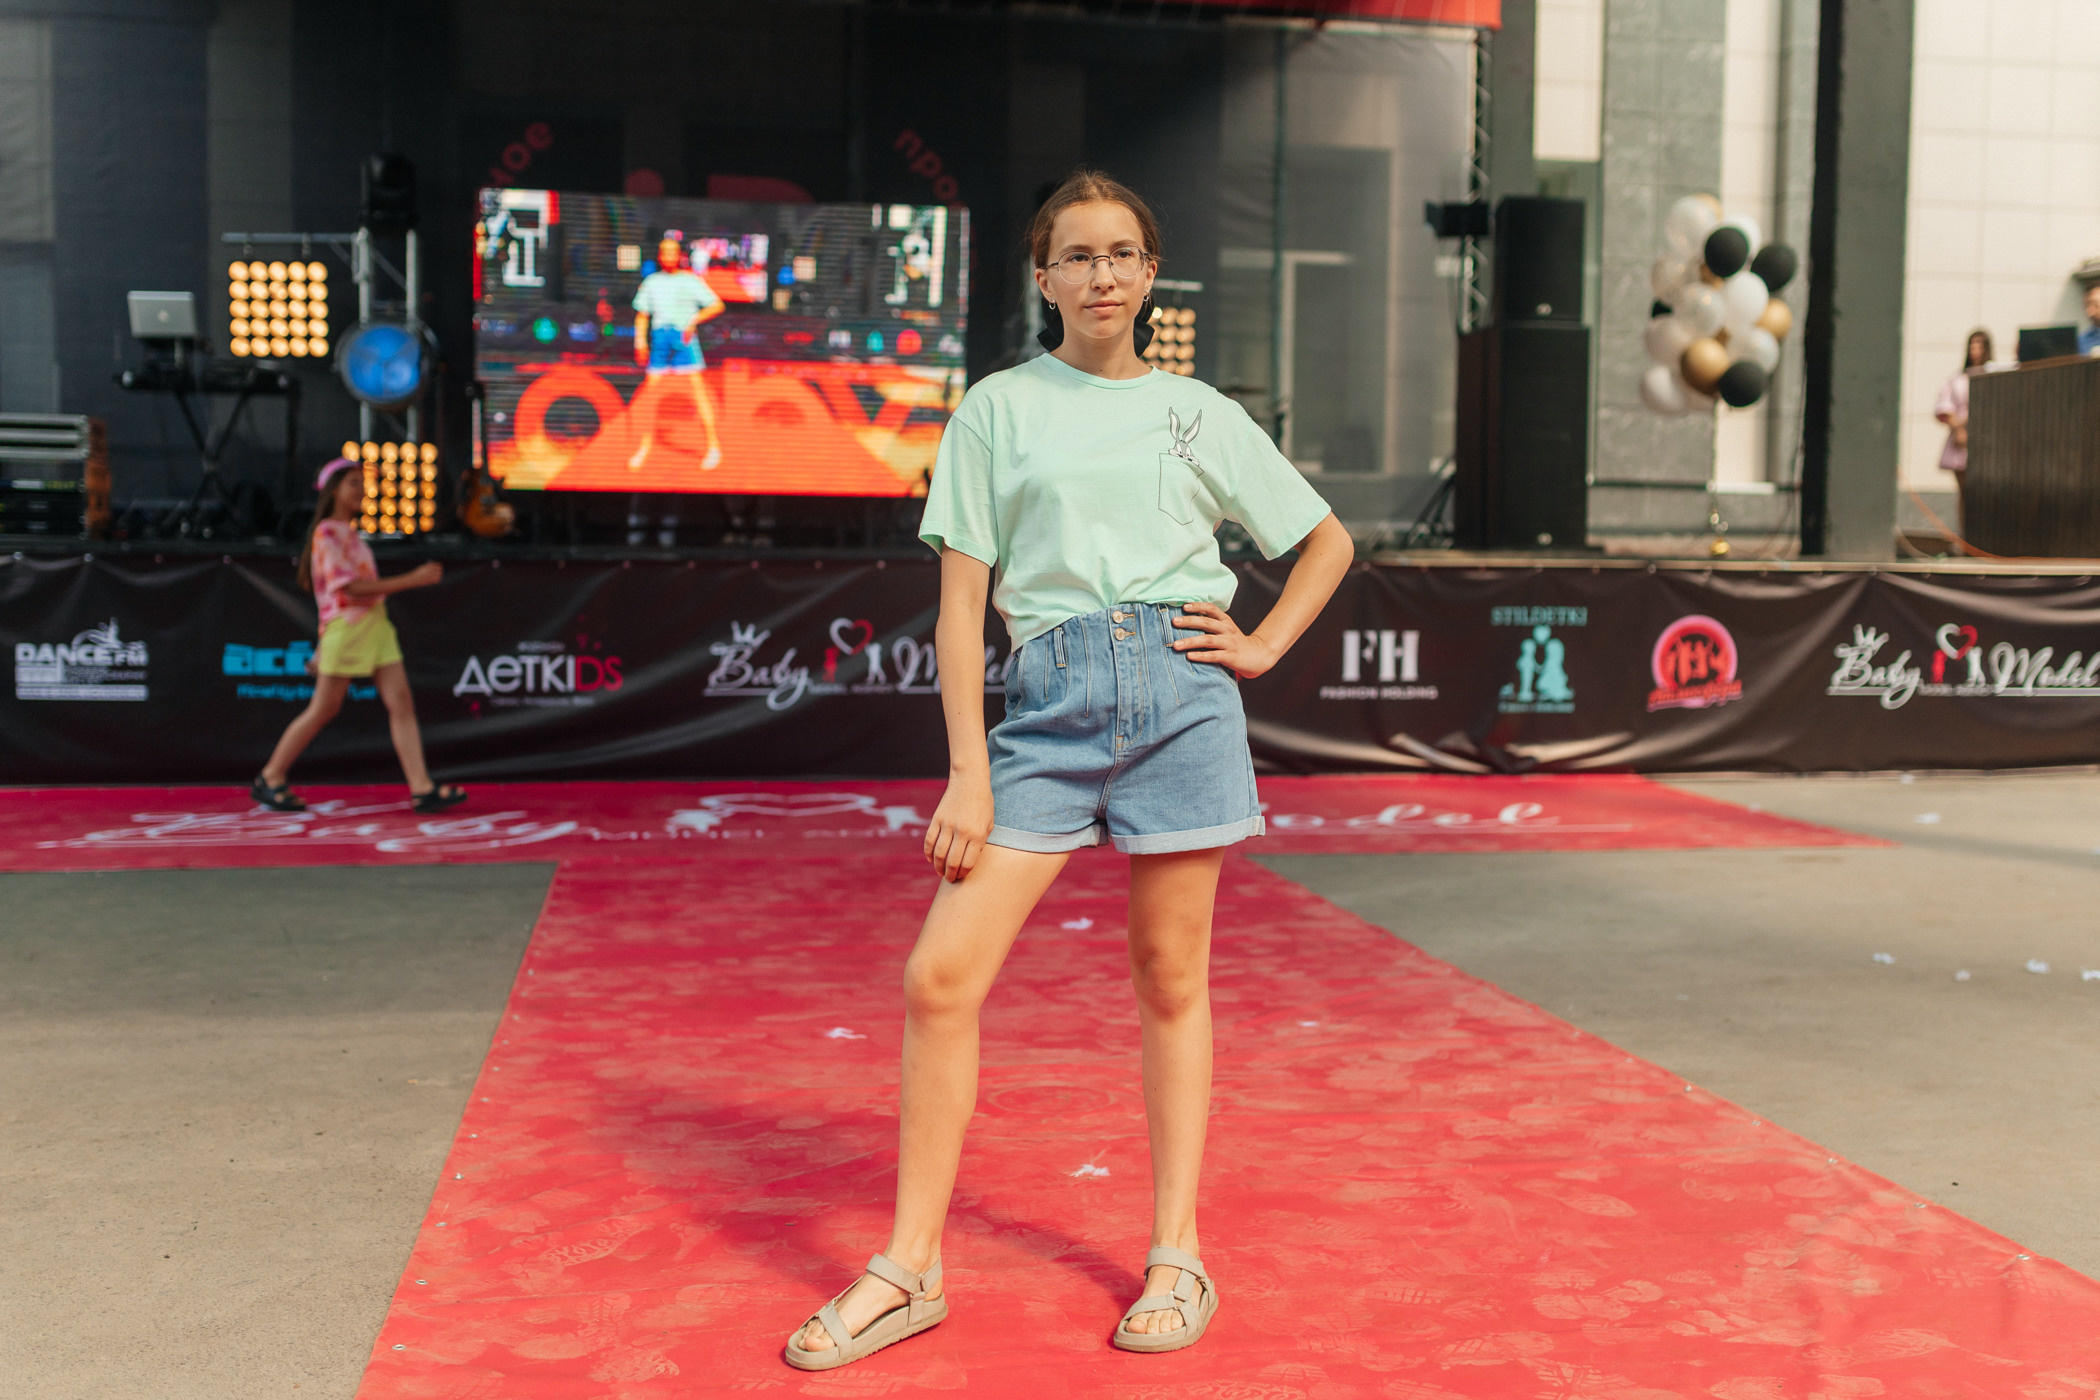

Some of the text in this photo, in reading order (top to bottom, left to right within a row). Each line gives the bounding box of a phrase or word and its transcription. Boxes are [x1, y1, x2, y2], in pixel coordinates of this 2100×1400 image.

[15, 643, 114, 667] DANCE
[705, 640, 809, 711] Baby
[1342, 630, 1420, 682] FH
[1830, 643, 1921, 710] Baby
